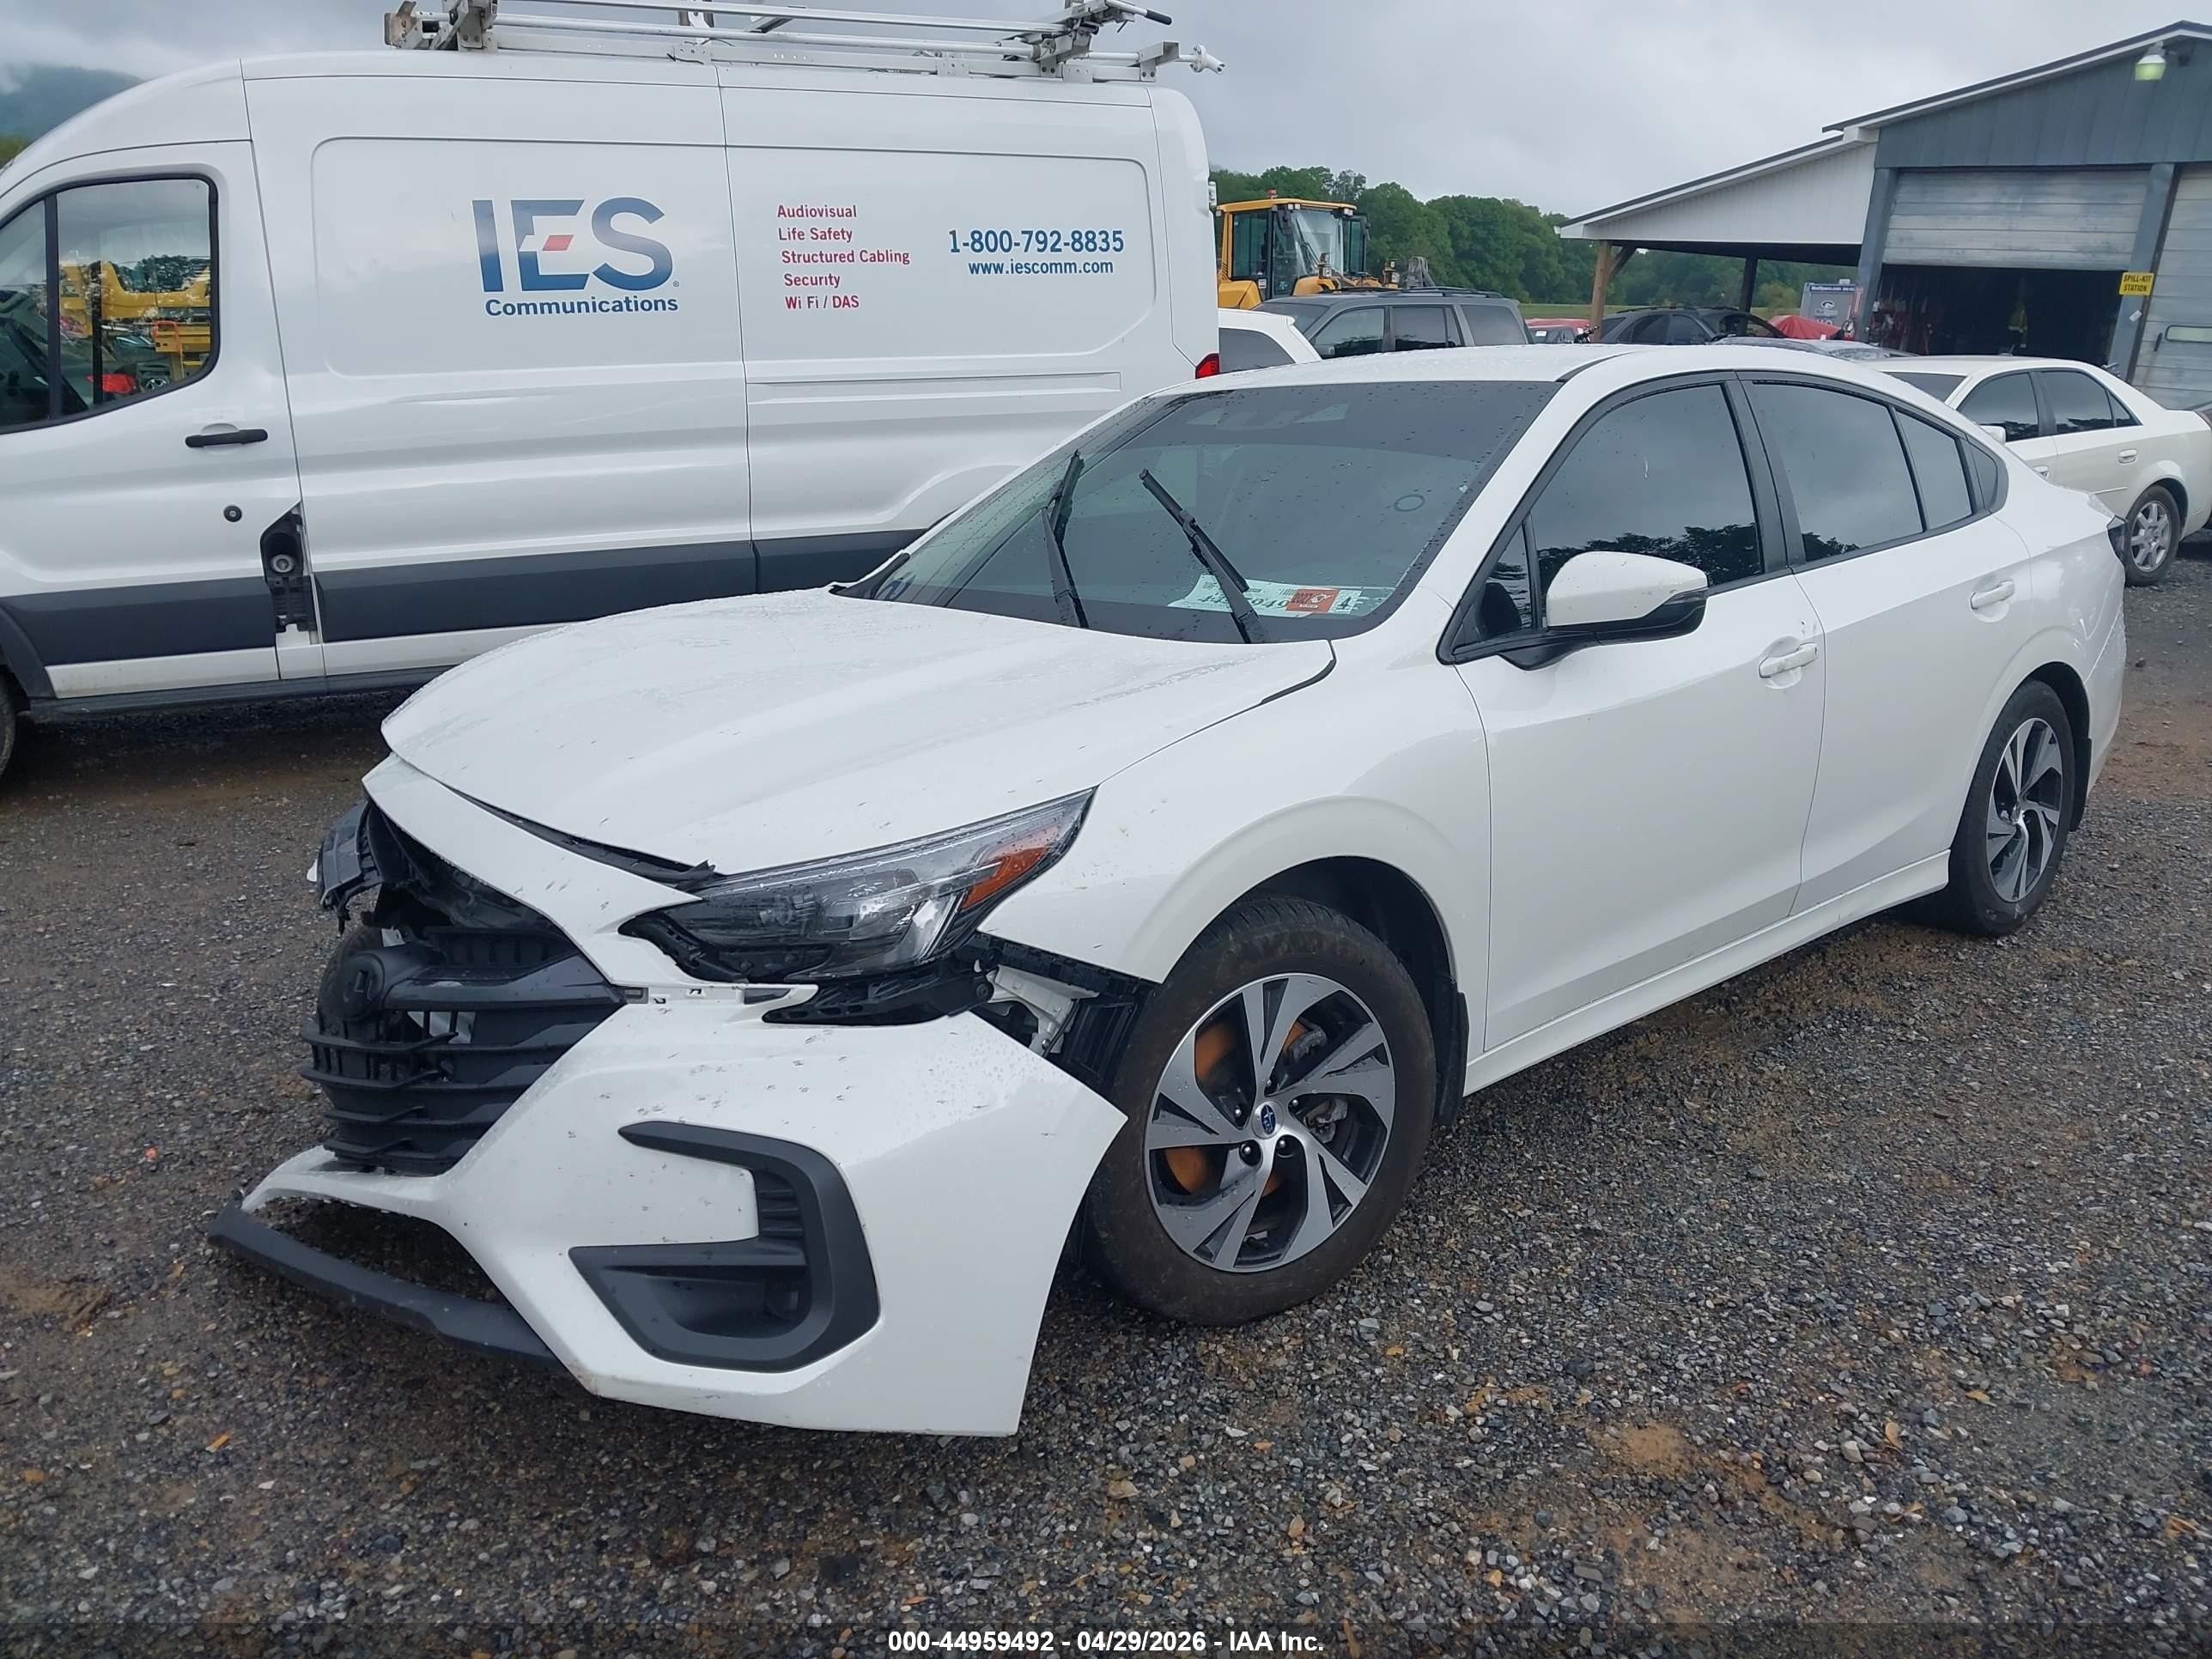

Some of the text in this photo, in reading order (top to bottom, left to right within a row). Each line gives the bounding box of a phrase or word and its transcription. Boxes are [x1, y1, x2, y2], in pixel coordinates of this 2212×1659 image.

[777, 204, 857, 218] Audiovisual
[778, 227, 853, 244] Life Safety
[948, 229, 1124, 253] 1-800-792-8835
[472, 197, 673, 292] IES
[781, 249, 910, 265] Structured Cabling
[968, 258, 1114, 275] www.iescomm.com
[783, 273, 841, 289] Security
[485, 295, 678, 317] Communications
[784, 295, 802, 310] Wi
[806, 295, 819, 309] Fi
[832, 295, 860, 309] DAS
